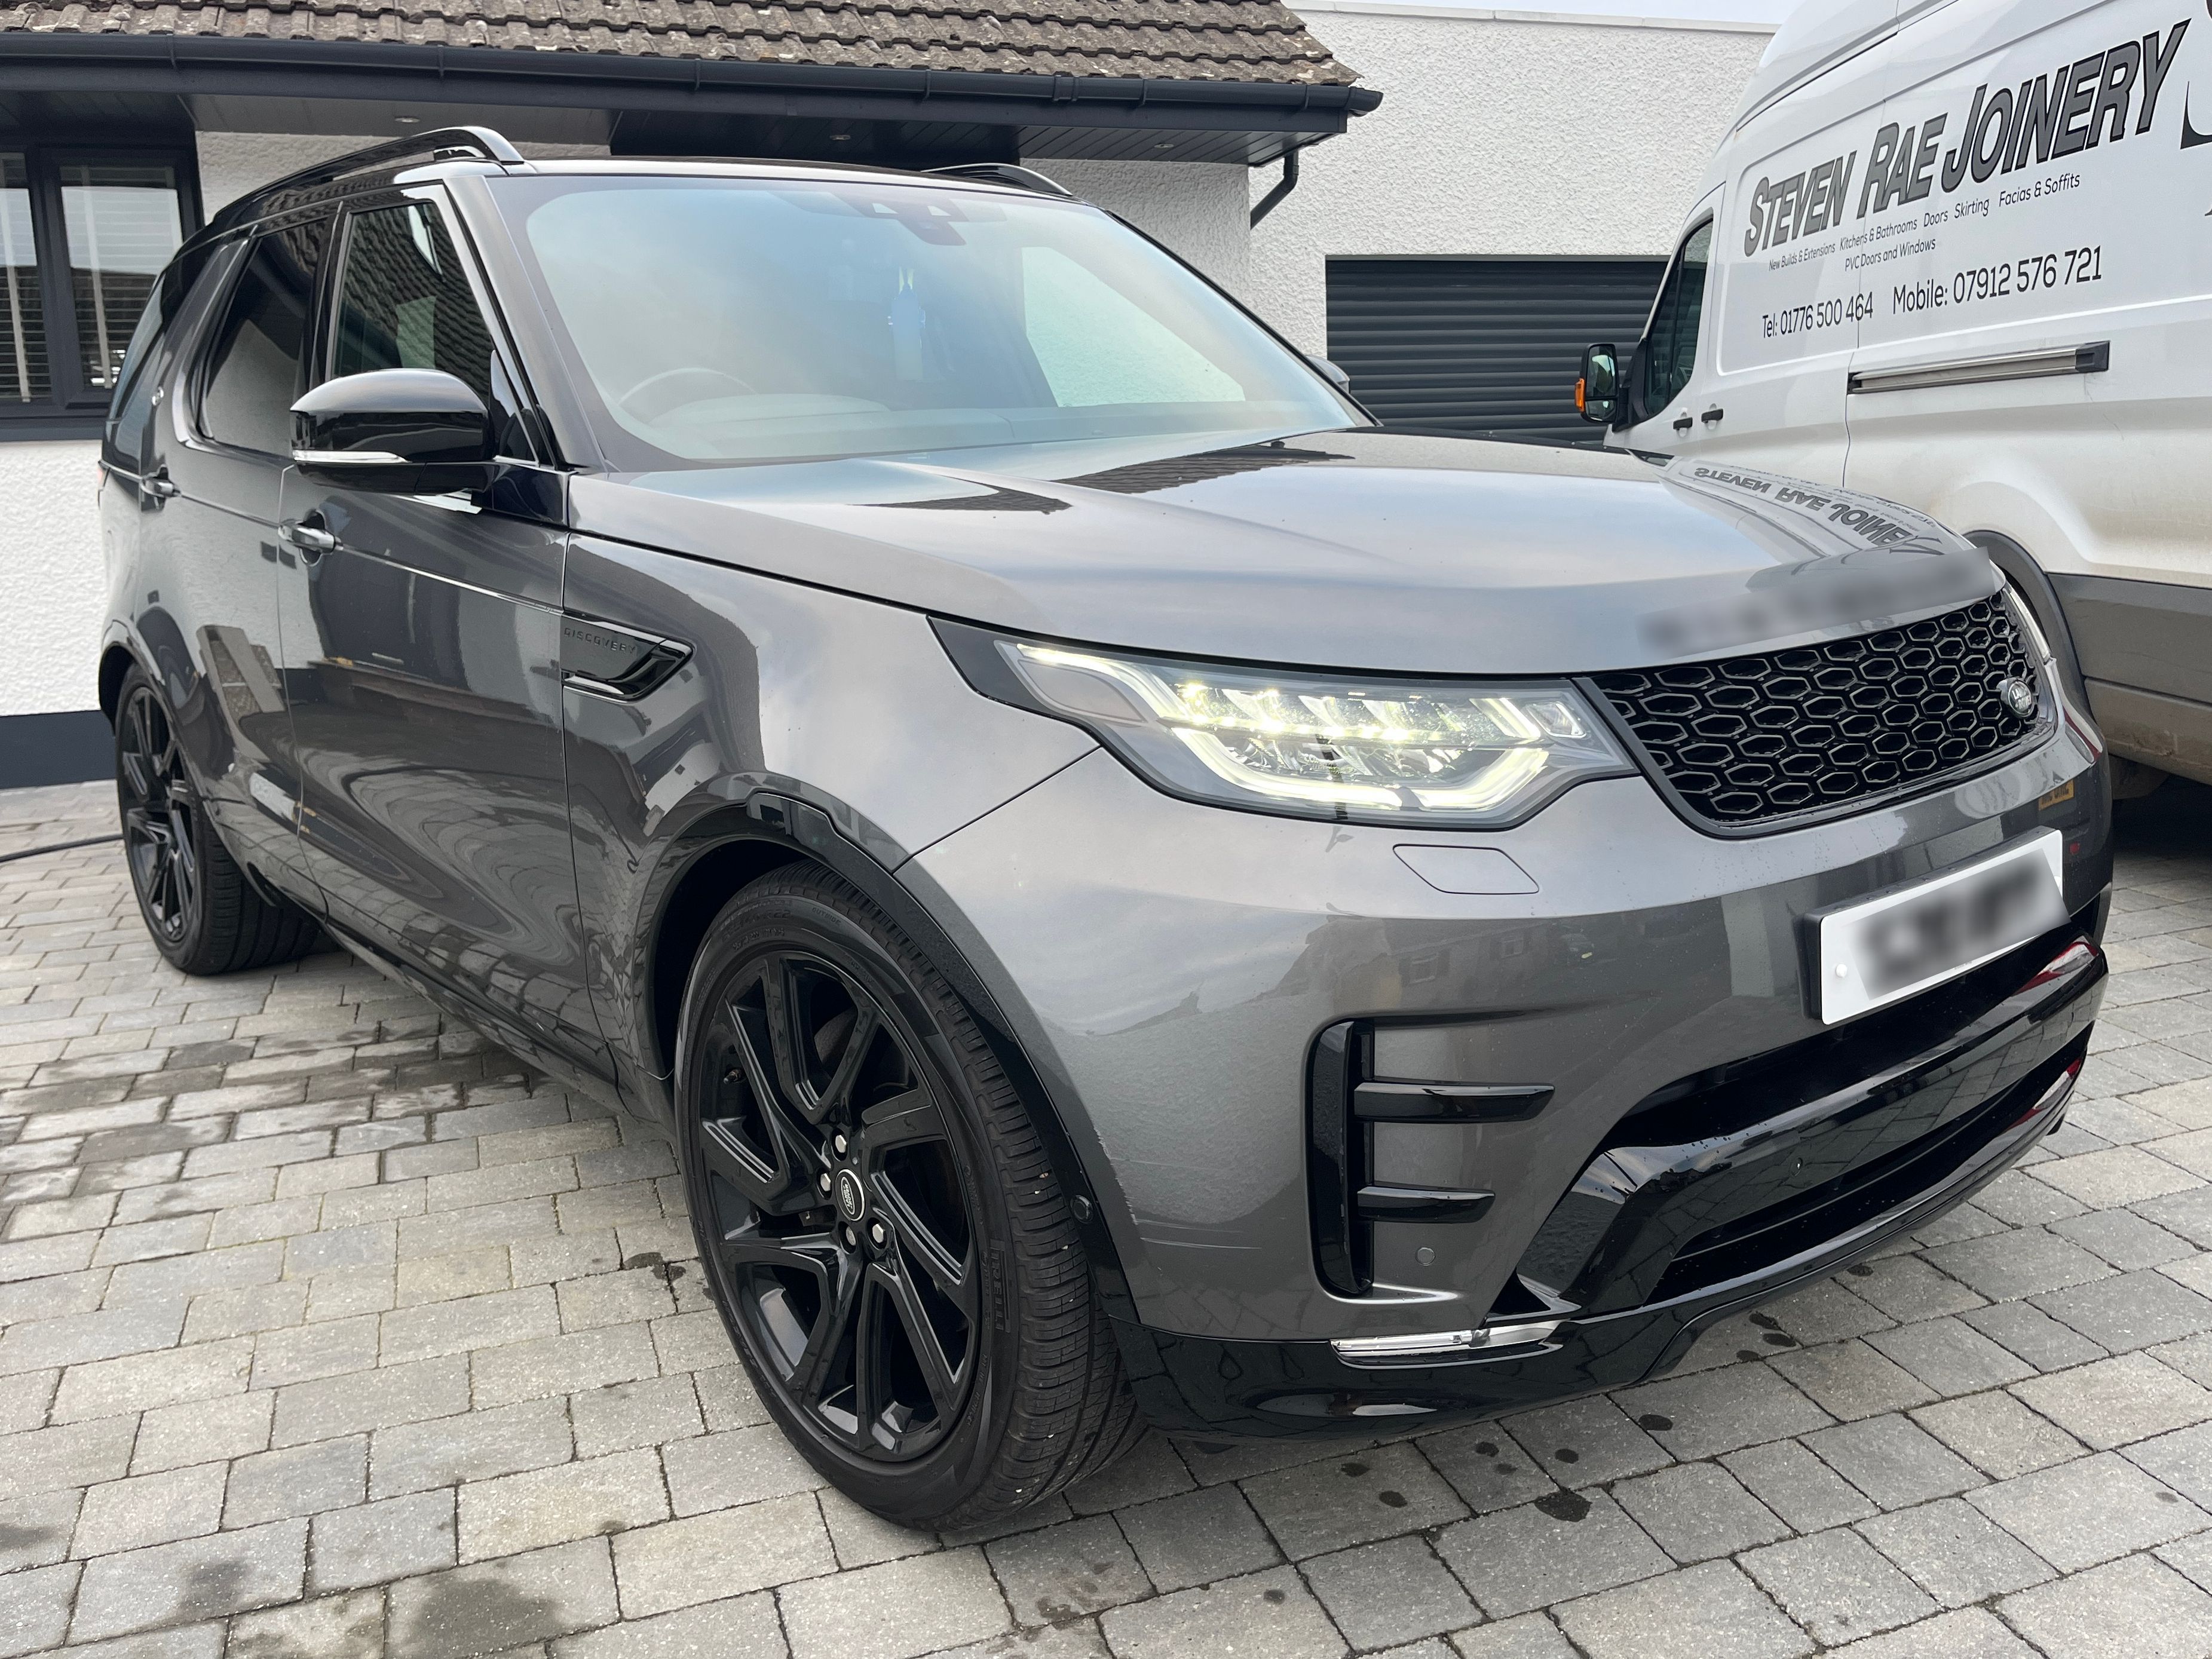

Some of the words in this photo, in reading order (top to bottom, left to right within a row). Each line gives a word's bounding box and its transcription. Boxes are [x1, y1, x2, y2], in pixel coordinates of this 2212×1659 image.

[1744, 150, 1857, 257] STEVEN
[1856, 112, 1948, 219] RAE
[1941, 18, 2192, 193] JOINERY
[1769, 259, 1779, 272] New
[1781, 253, 1797, 268] Builds
[1798, 250, 1803, 262] &
[1803, 242, 1836, 260] Extensions
[1839, 232, 1868, 251] Kitchens
[1869, 228, 1874, 242] &
[1876, 219, 1917, 240] Bathrooms
[1923, 210, 1948, 227] Doors
[1954, 199, 1990, 219] Skirting
[1999, 187, 2031, 207] Facias
[2034, 181, 2041, 198] &
[2044, 173, 2080, 195] Soffits
[1845, 255, 1859, 272] PVC
[1861, 252, 1882, 267] Doors
[1883, 244, 1898, 262] and
[1899, 238, 1936, 257] Windows
[1763, 313, 1778, 338] Tel:
[1780, 305, 1813, 335] 01776
[1816, 299, 1842, 328] 500
[1846, 292, 1873, 323] 464
[1893, 278, 1948, 314] Mobile:
[1953, 263, 2011, 303] 07912
[2017, 253, 2057, 292] 576
[2064, 245, 2102, 285] 721
[564, 627, 637, 655] DISCOVERY
[989, 1238, 1012, 1333] PIRELLI
